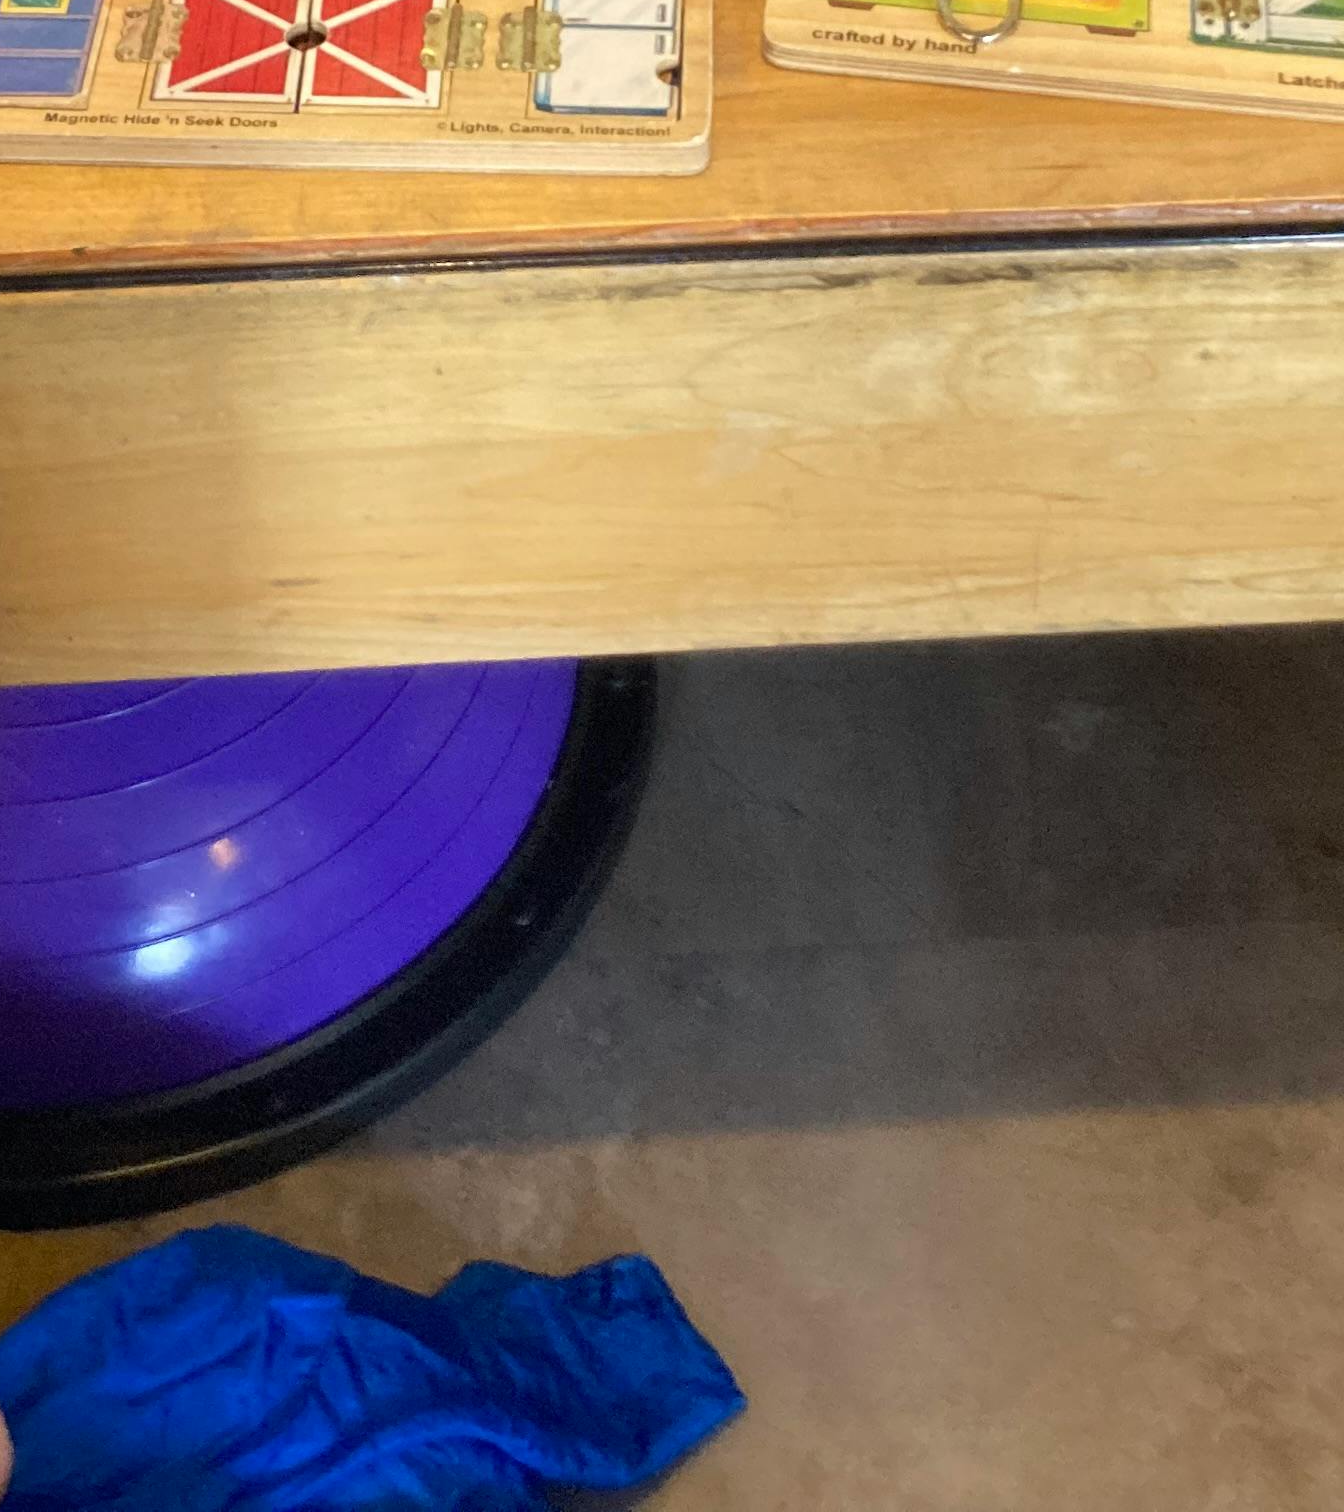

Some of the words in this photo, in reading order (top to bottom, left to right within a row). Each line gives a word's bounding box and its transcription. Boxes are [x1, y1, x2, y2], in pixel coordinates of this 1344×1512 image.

[812, 29, 885, 46] crafted
[891, 34, 916, 51] by
[924, 38, 978, 55] hand
[44, 111, 118, 125] Magnetic
[124, 113, 160, 125] Hide
[184, 115, 225, 127] Seek
[229, 116, 278, 129] Doors
[450, 121, 504, 134] Lights,
[509, 122, 574, 135] Camera,
[579, 124, 672, 138] Interaction!
